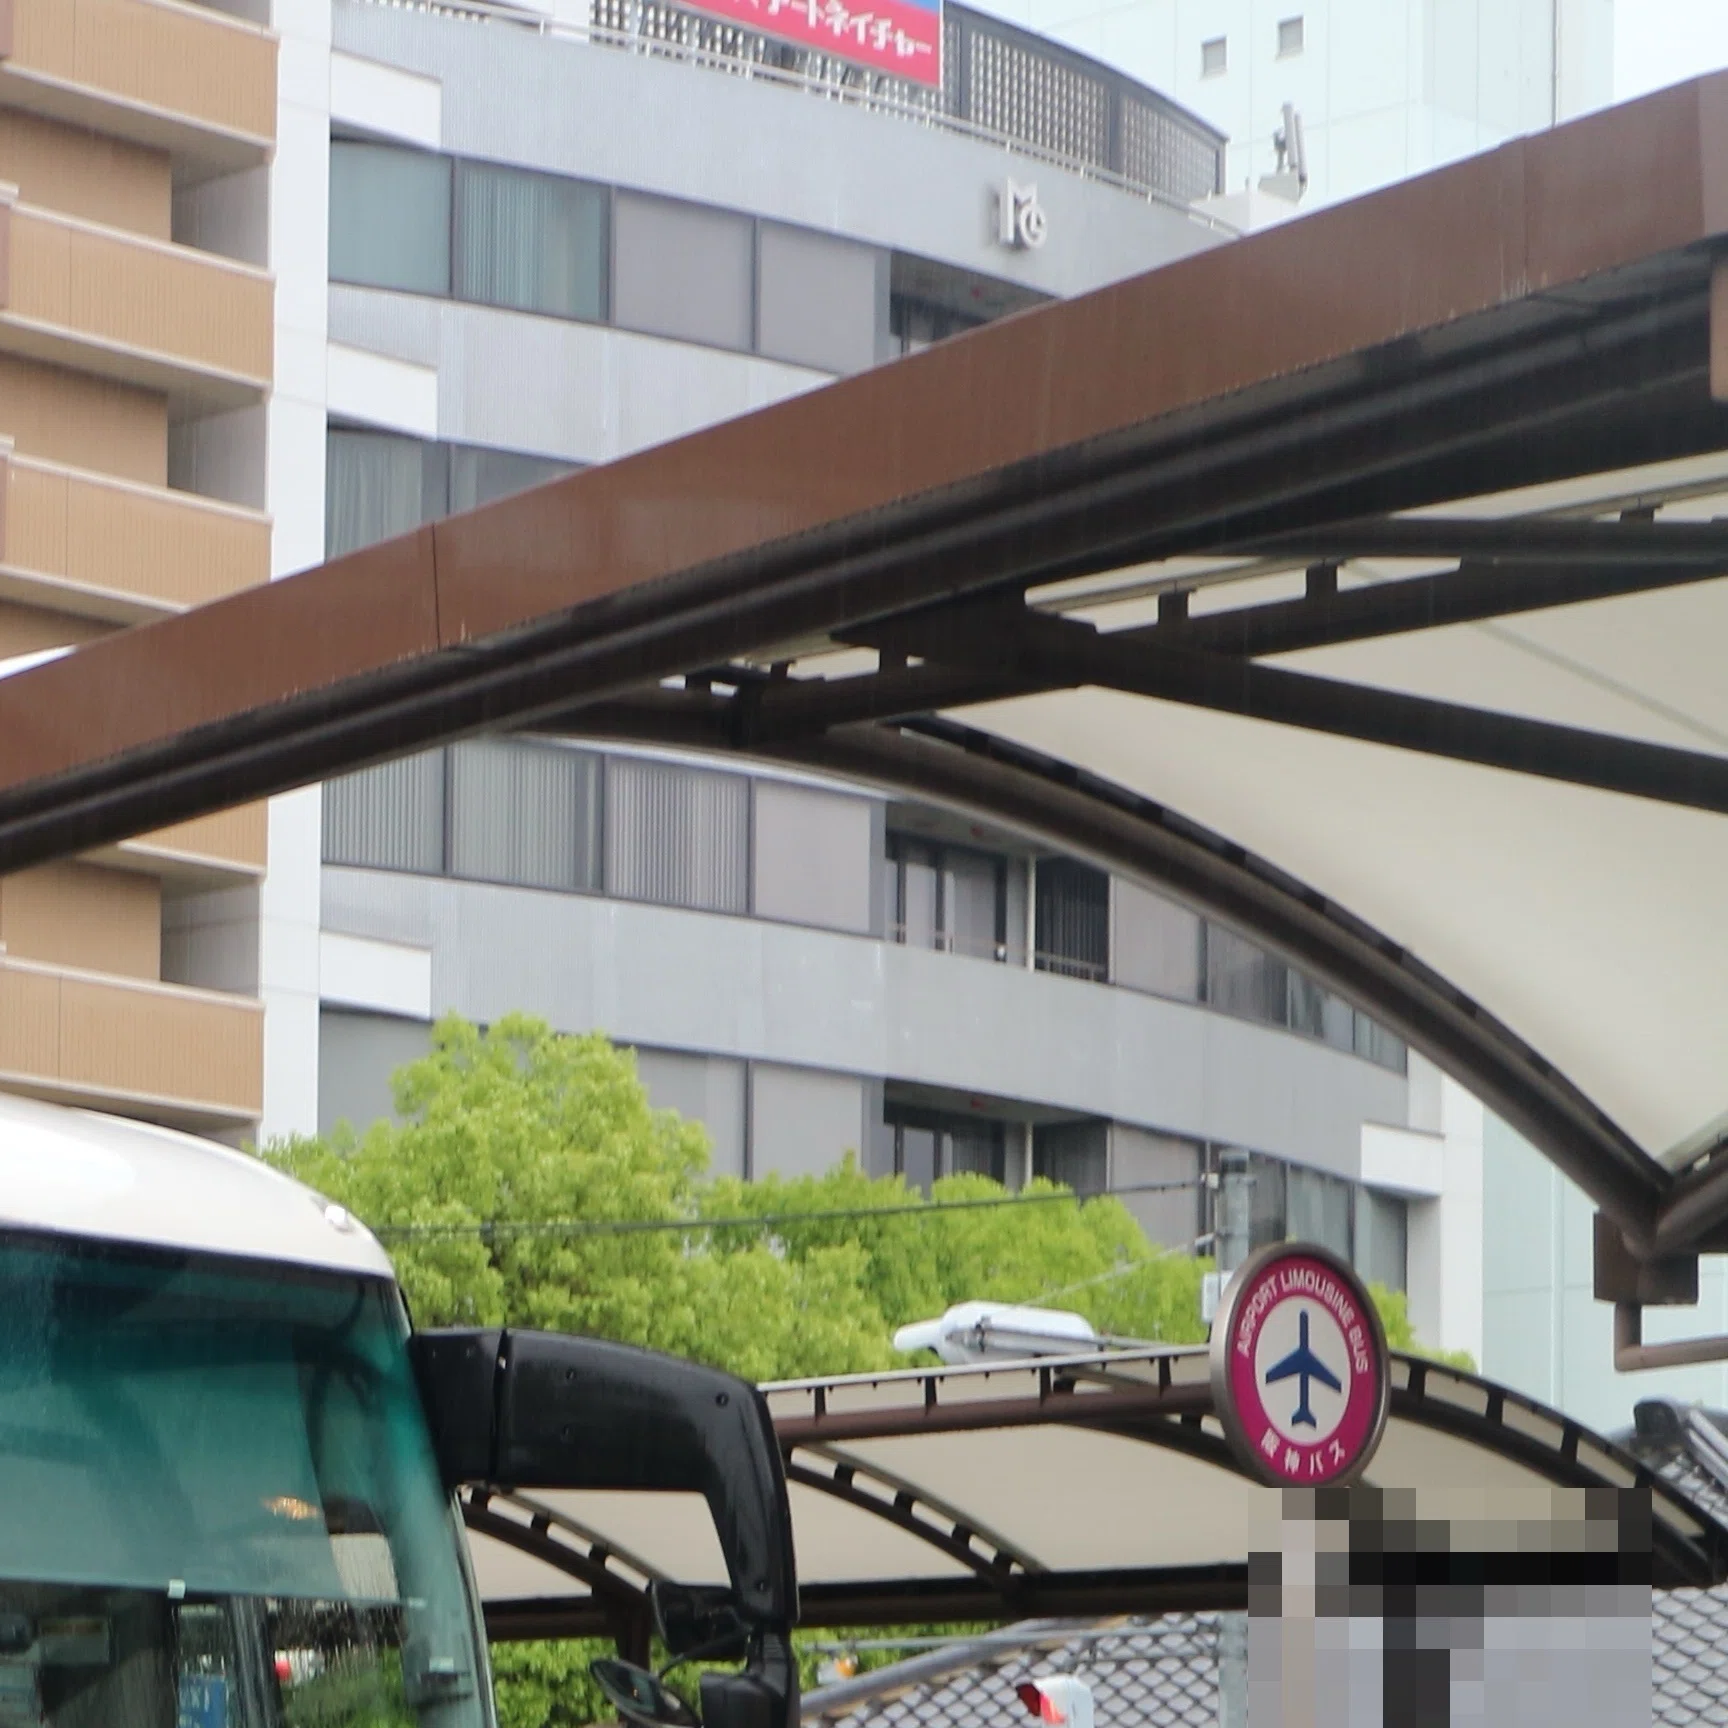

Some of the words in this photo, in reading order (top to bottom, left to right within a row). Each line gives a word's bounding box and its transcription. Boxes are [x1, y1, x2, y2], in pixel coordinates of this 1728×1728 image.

[1236, 1272, 1279, 1358] AIRPORT
[1280, 1267, 1357, 1330] LIMOUSINE
[1347, 1321, 1369, 1375] BUS
[1260, 1426, 1346, 1477] 阪神バス
